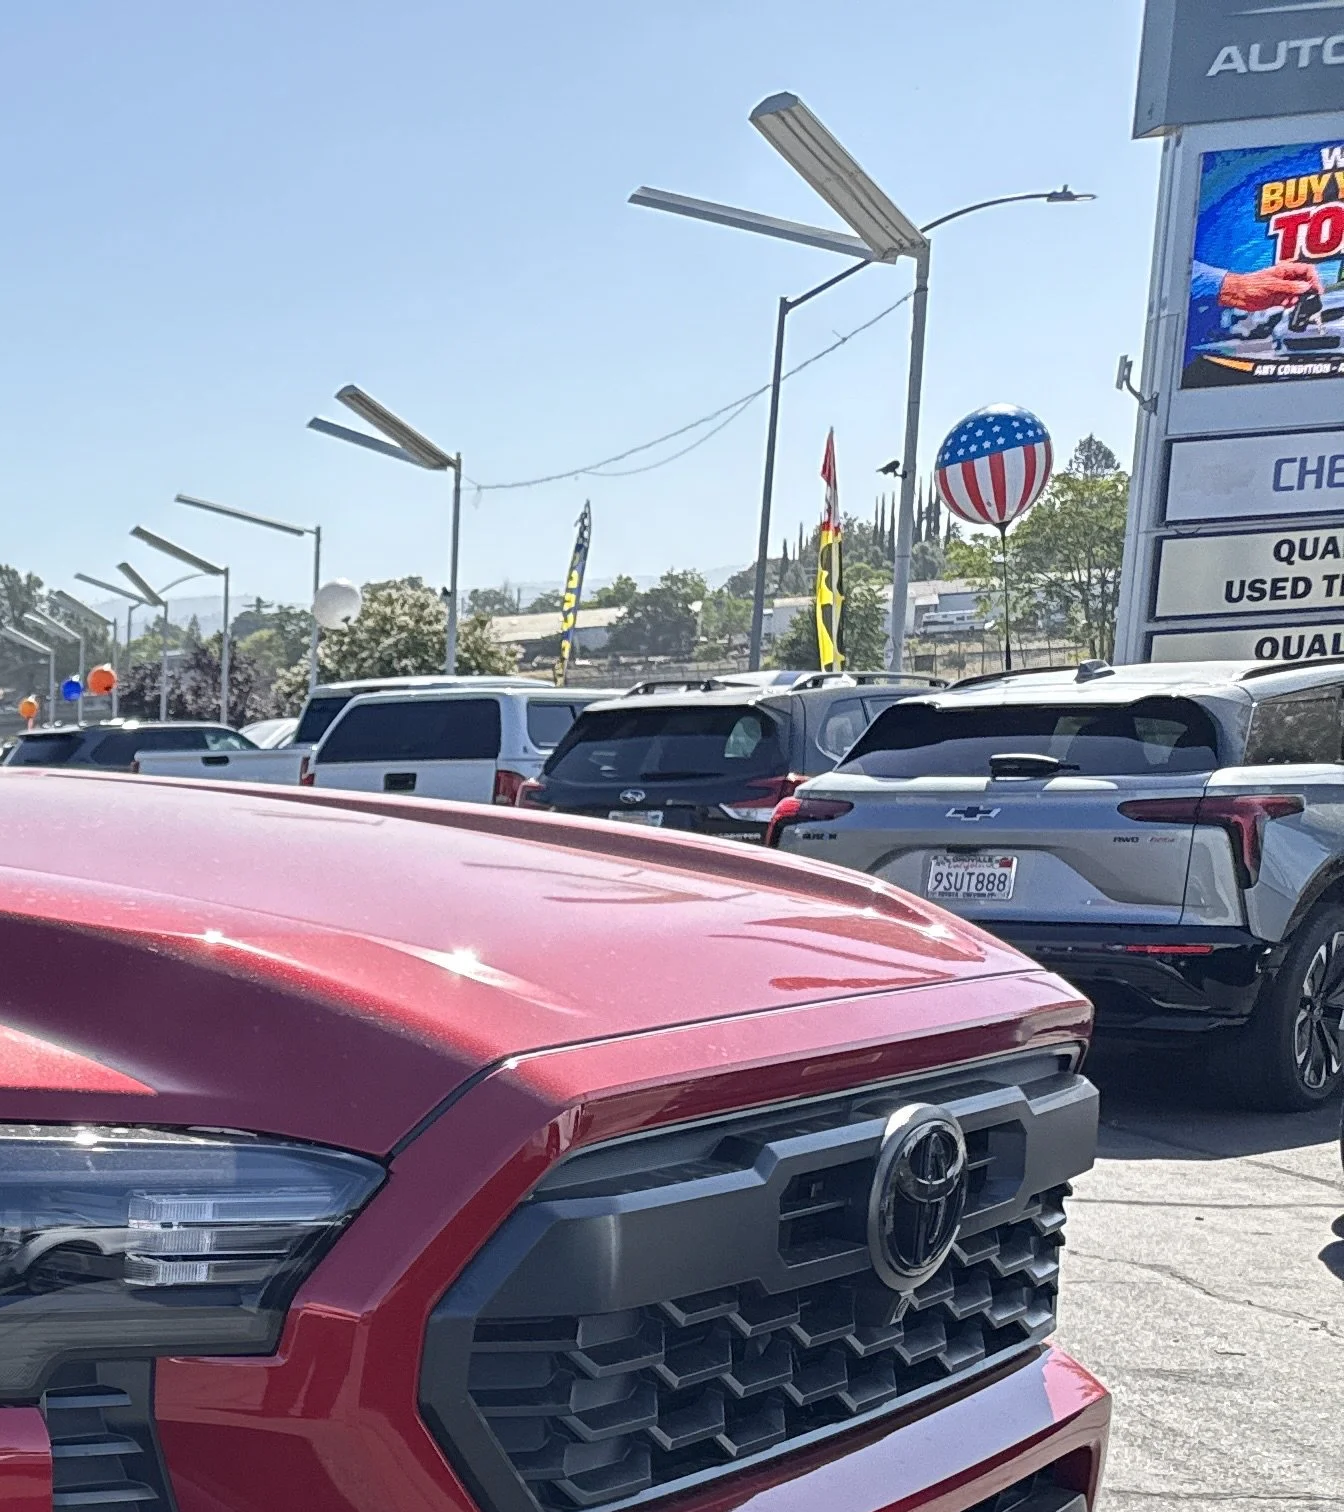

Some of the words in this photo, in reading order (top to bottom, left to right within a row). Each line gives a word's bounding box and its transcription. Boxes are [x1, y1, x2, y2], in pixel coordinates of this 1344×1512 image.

[1260, 171, 1332, 216] BUY
[1254, 364, 1277, 377] ANY
[1277, 362, 1331, 376] CONDITION
[1273, 535, 1344, 566] QUA
[1224, 576, 1313, 604] USED
[932, 871, 1008, 892] 9SUT888
